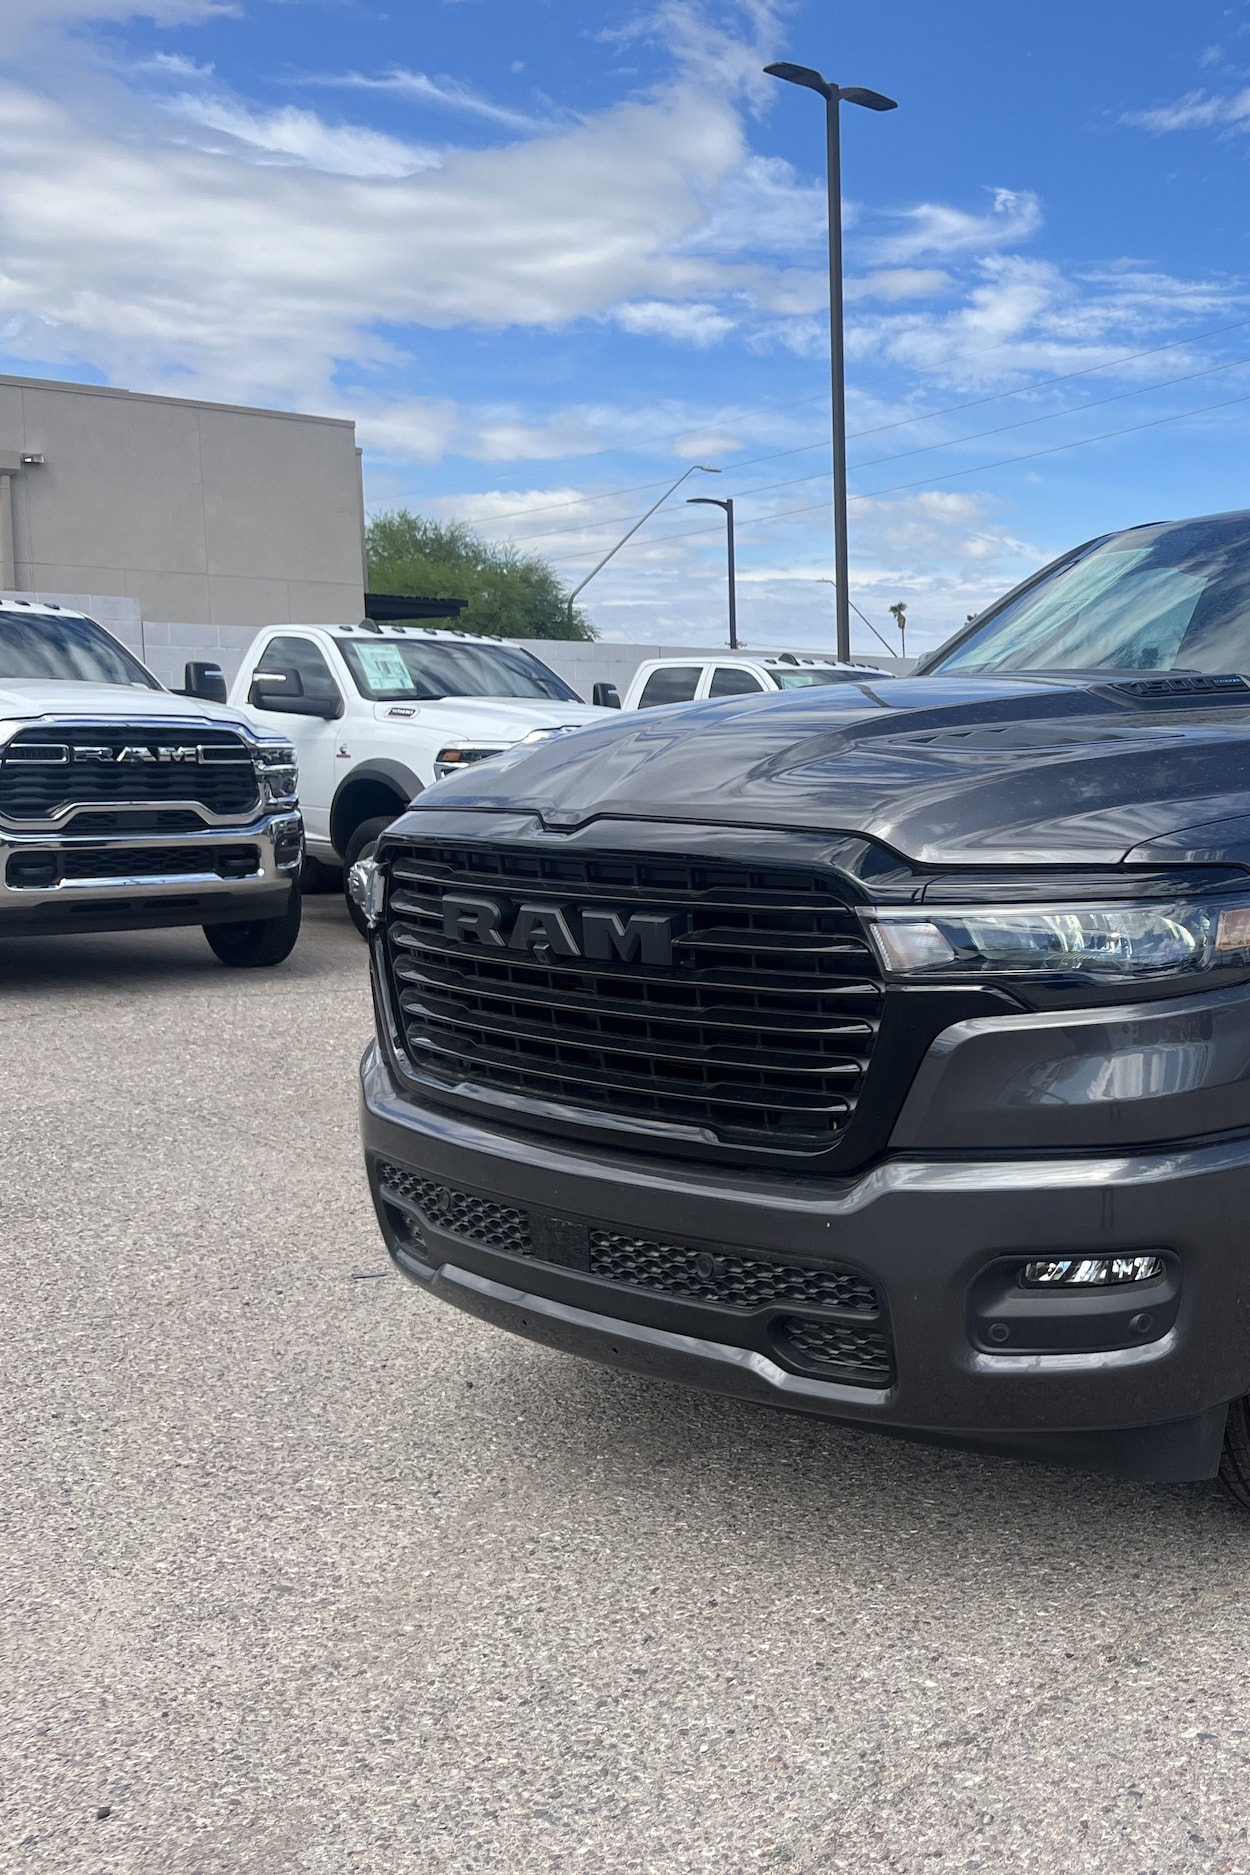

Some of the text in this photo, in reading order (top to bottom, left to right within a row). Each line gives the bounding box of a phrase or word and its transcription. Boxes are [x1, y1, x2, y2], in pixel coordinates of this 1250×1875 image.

[1130, 678, 1212, 694] 1500
[73, 746, 198, 763] RAM
[442, 891, 680, 966] RAM
